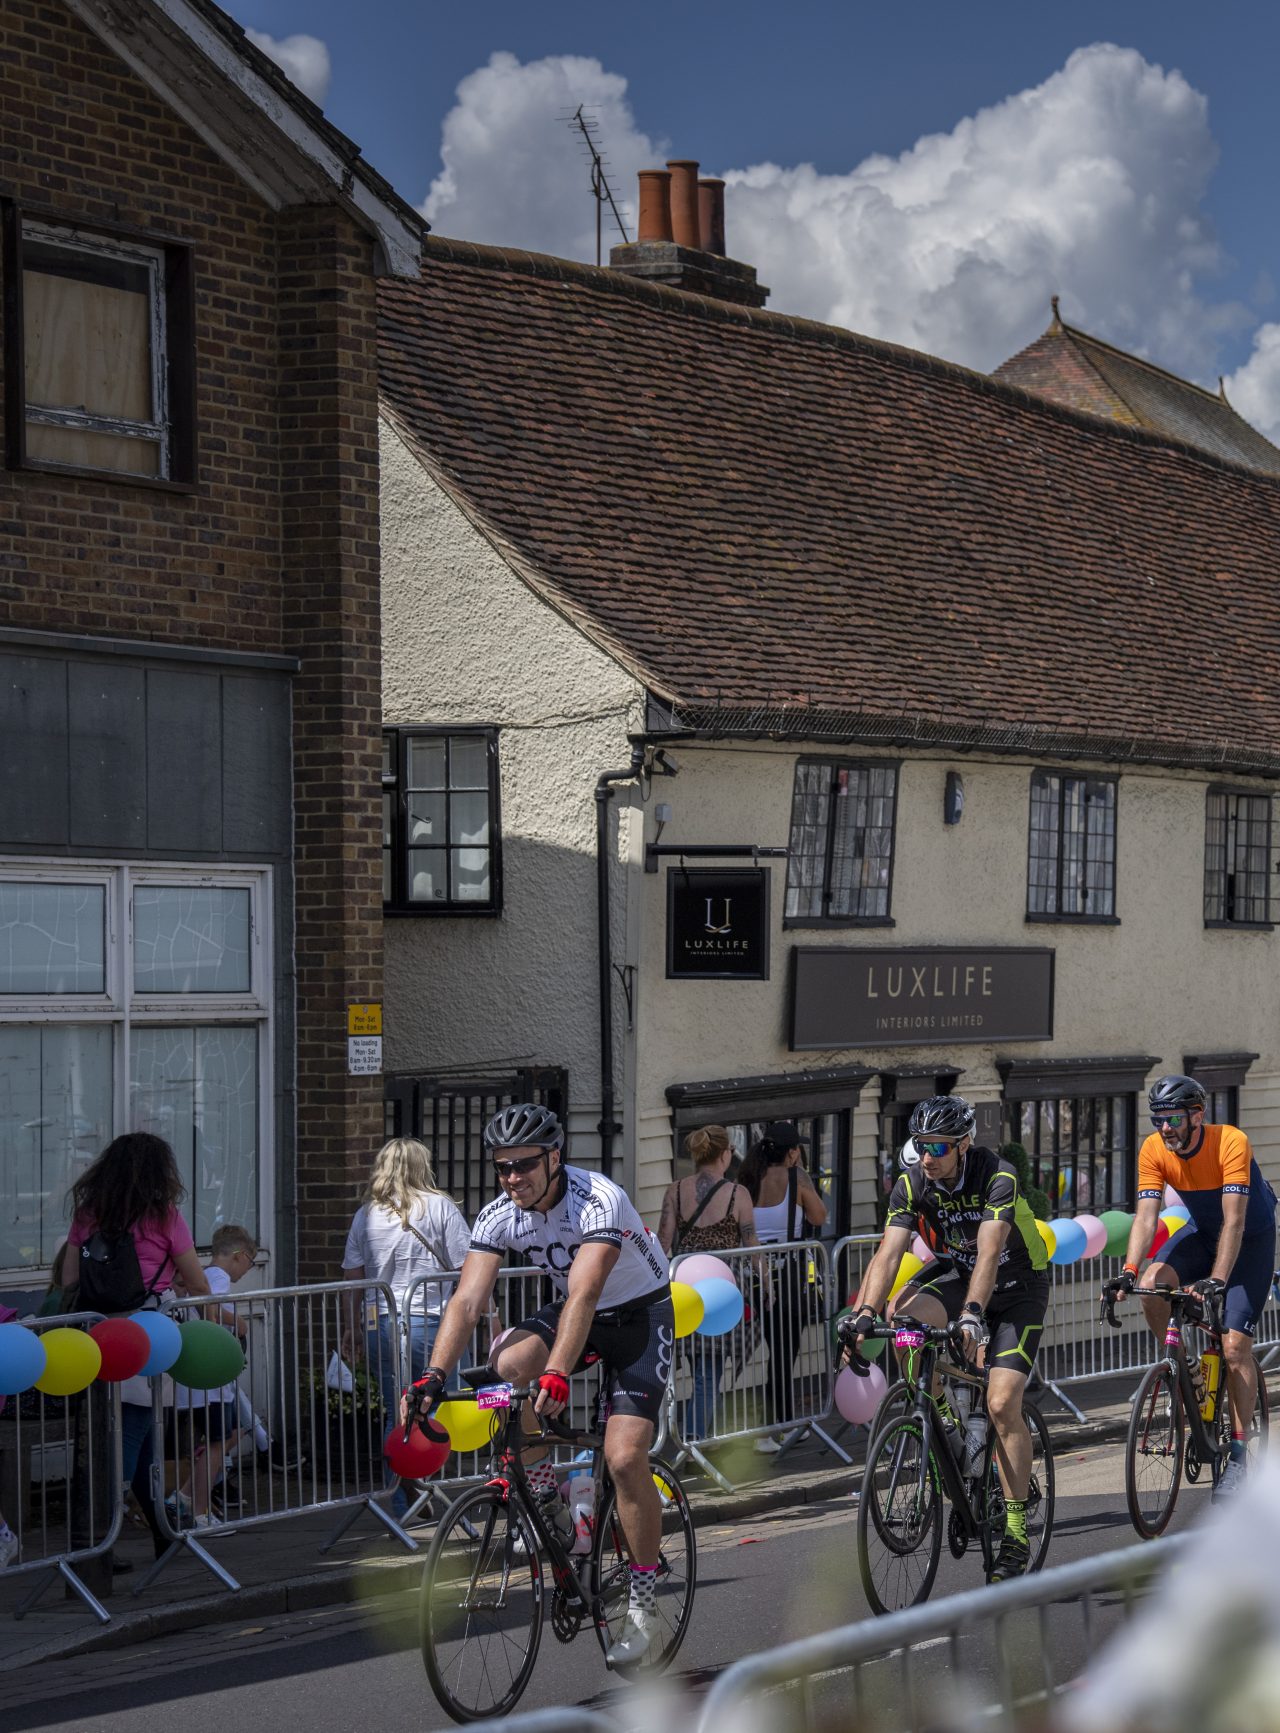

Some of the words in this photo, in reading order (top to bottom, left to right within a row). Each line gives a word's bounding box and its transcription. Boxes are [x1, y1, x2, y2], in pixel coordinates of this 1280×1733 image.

[685, 940, 749, 949] LUXLIFE
[867, 966, 993, 998] LUXLIFE
[876, 1016, 936, 1029] INTERIORS
[940, 1014, 984, 1027] LIMITED
[1138, 1190, 1146, 1198] LE
[1225, 1185, 1241, 1193] COL
[647, 1253, 664, 1280] SHOES
[1243, 1321, 1256, 1334] LE
[655, 1324, 674, 1384] CCC
